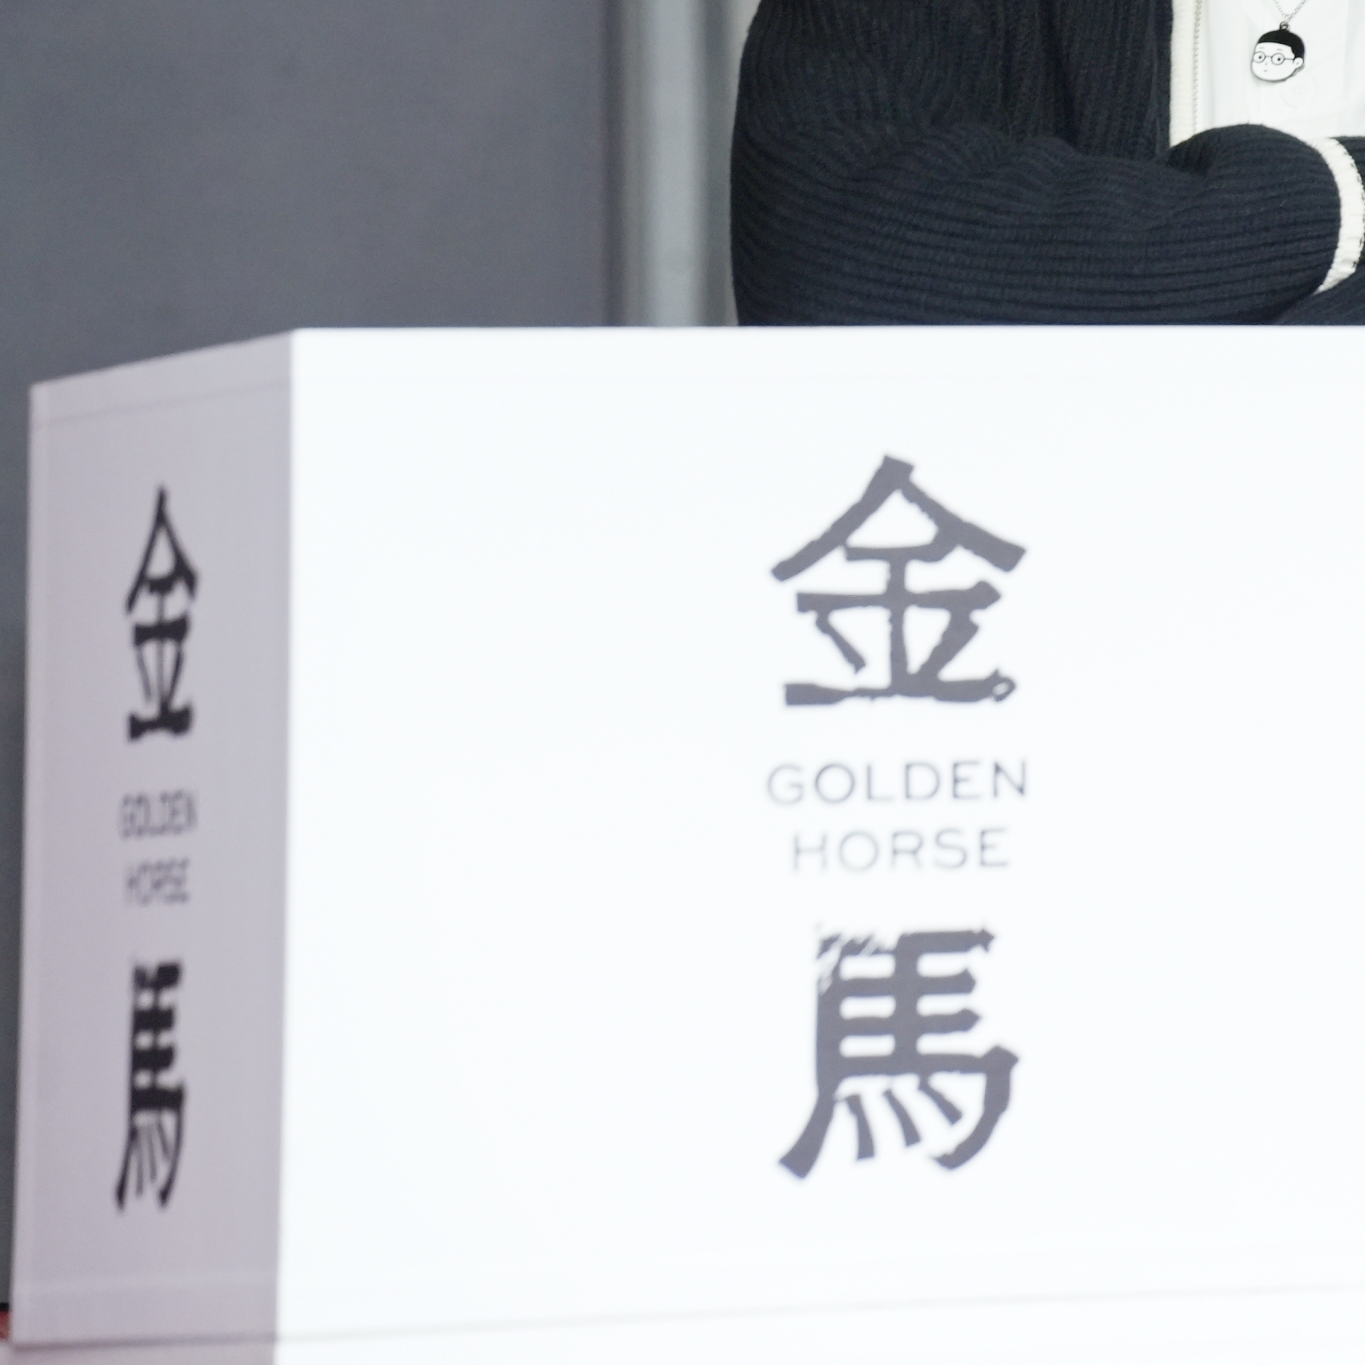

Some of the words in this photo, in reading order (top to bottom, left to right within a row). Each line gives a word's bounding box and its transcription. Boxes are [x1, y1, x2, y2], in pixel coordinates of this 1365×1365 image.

[124, 485, 198, 743] 金
[769, 453, 1028, 708] 金
[119, 789, 198, 840] GOLDEN
[765, 758, 1029, 806] GOLDEN
[791, 826, 1011, 872] HORSE
[123, 857, 190, 907] HORSE
[113, 959, 188, 1212] 馬
[777, 926, 1021, 1181] 馬
